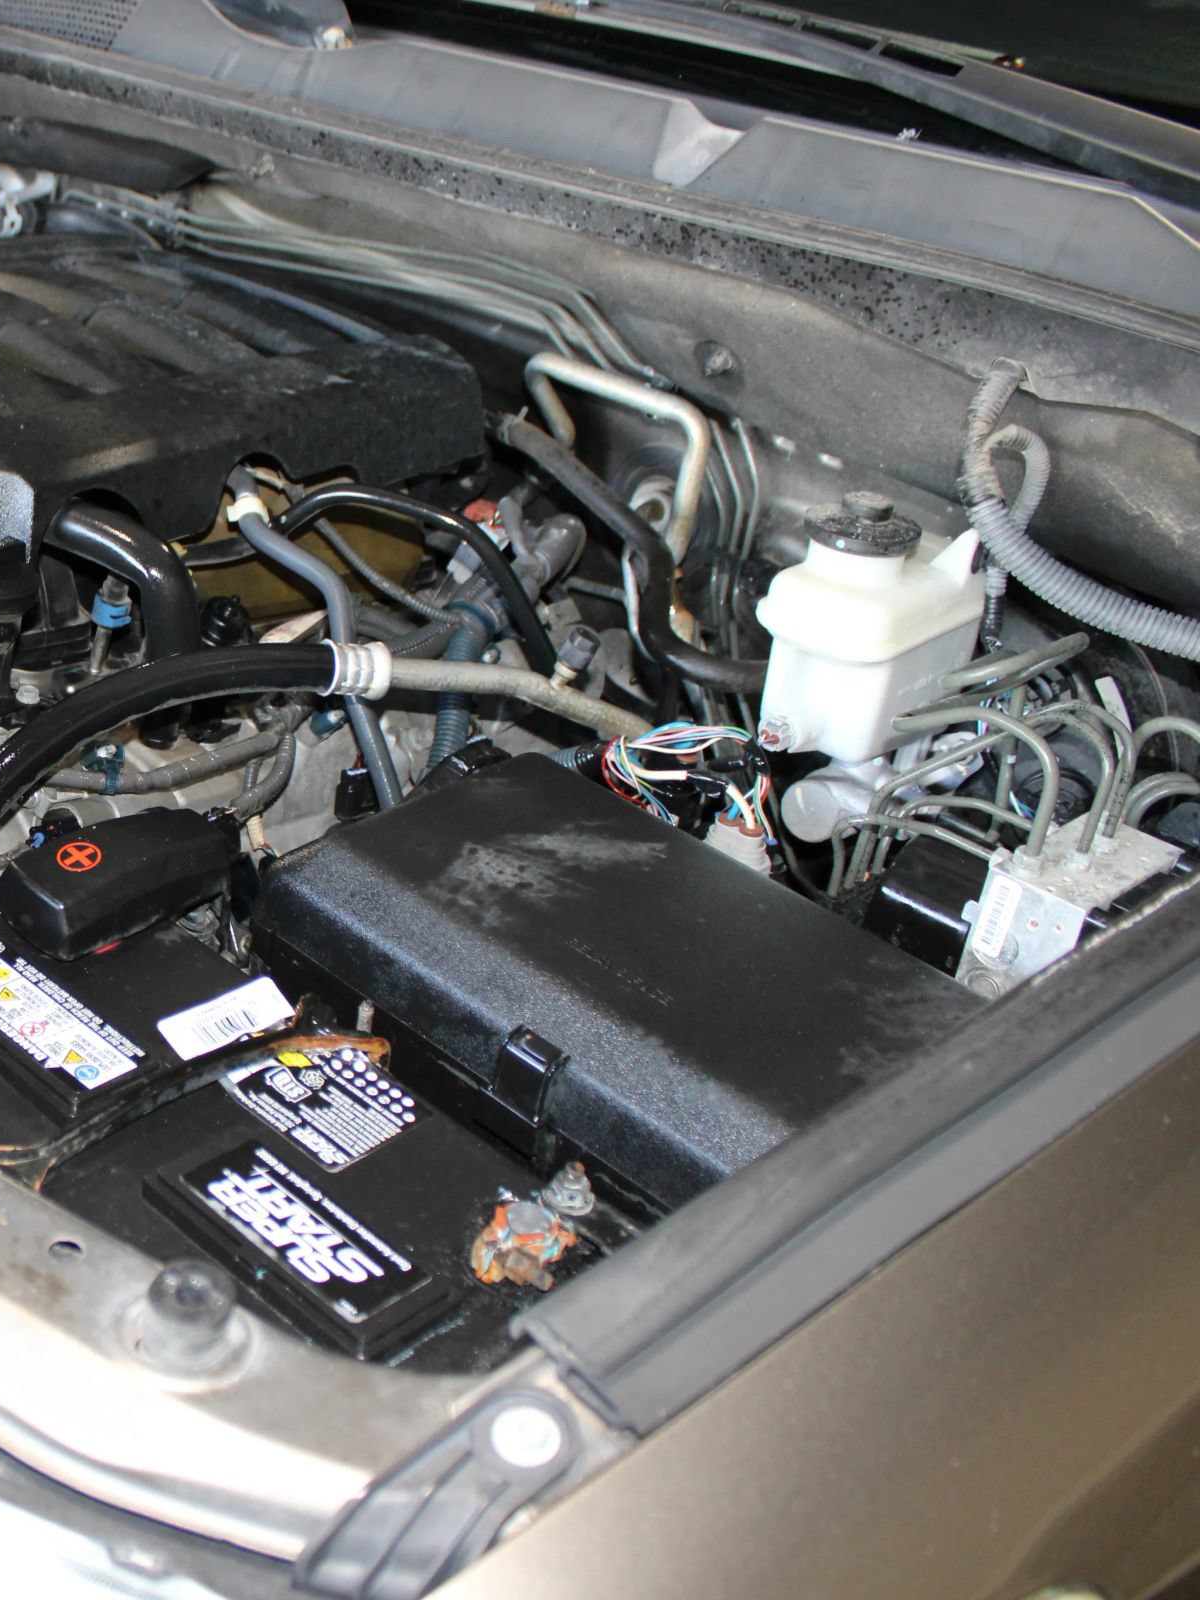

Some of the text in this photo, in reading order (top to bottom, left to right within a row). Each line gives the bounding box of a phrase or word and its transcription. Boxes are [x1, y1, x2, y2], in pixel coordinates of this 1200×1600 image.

[12, 962, 25, 972] ALL
[23, 964, 38, 974] NOT
[21, 969, 39, 982] READ
[34, 972, 46, 980] DO
[61, 1001, 73, 1009] OF
[65, 996, 84, 1009] OPEN
[69, 1007, 91, 1023] REACH
[80, 1007, 95, 1018] NOT
[87, 1020, 101, 1031] THE
[91, 1015, 104, 1024] DO
[97, 1028, 109, 1037] OF
[105, 1035, 120, 1046] OUT
[116, 1043, 134, 1056] KEEP
[291, 1128, 333, 1163] SUPER
[305, 1125, 350, 1163] START
[208, 1180, 330, 1283] SUPER
[229, 1173, 384, 1283] START
[357, 1226, 393, 1257] Automotive
[389, 1253, 412, 1272] Ozark
